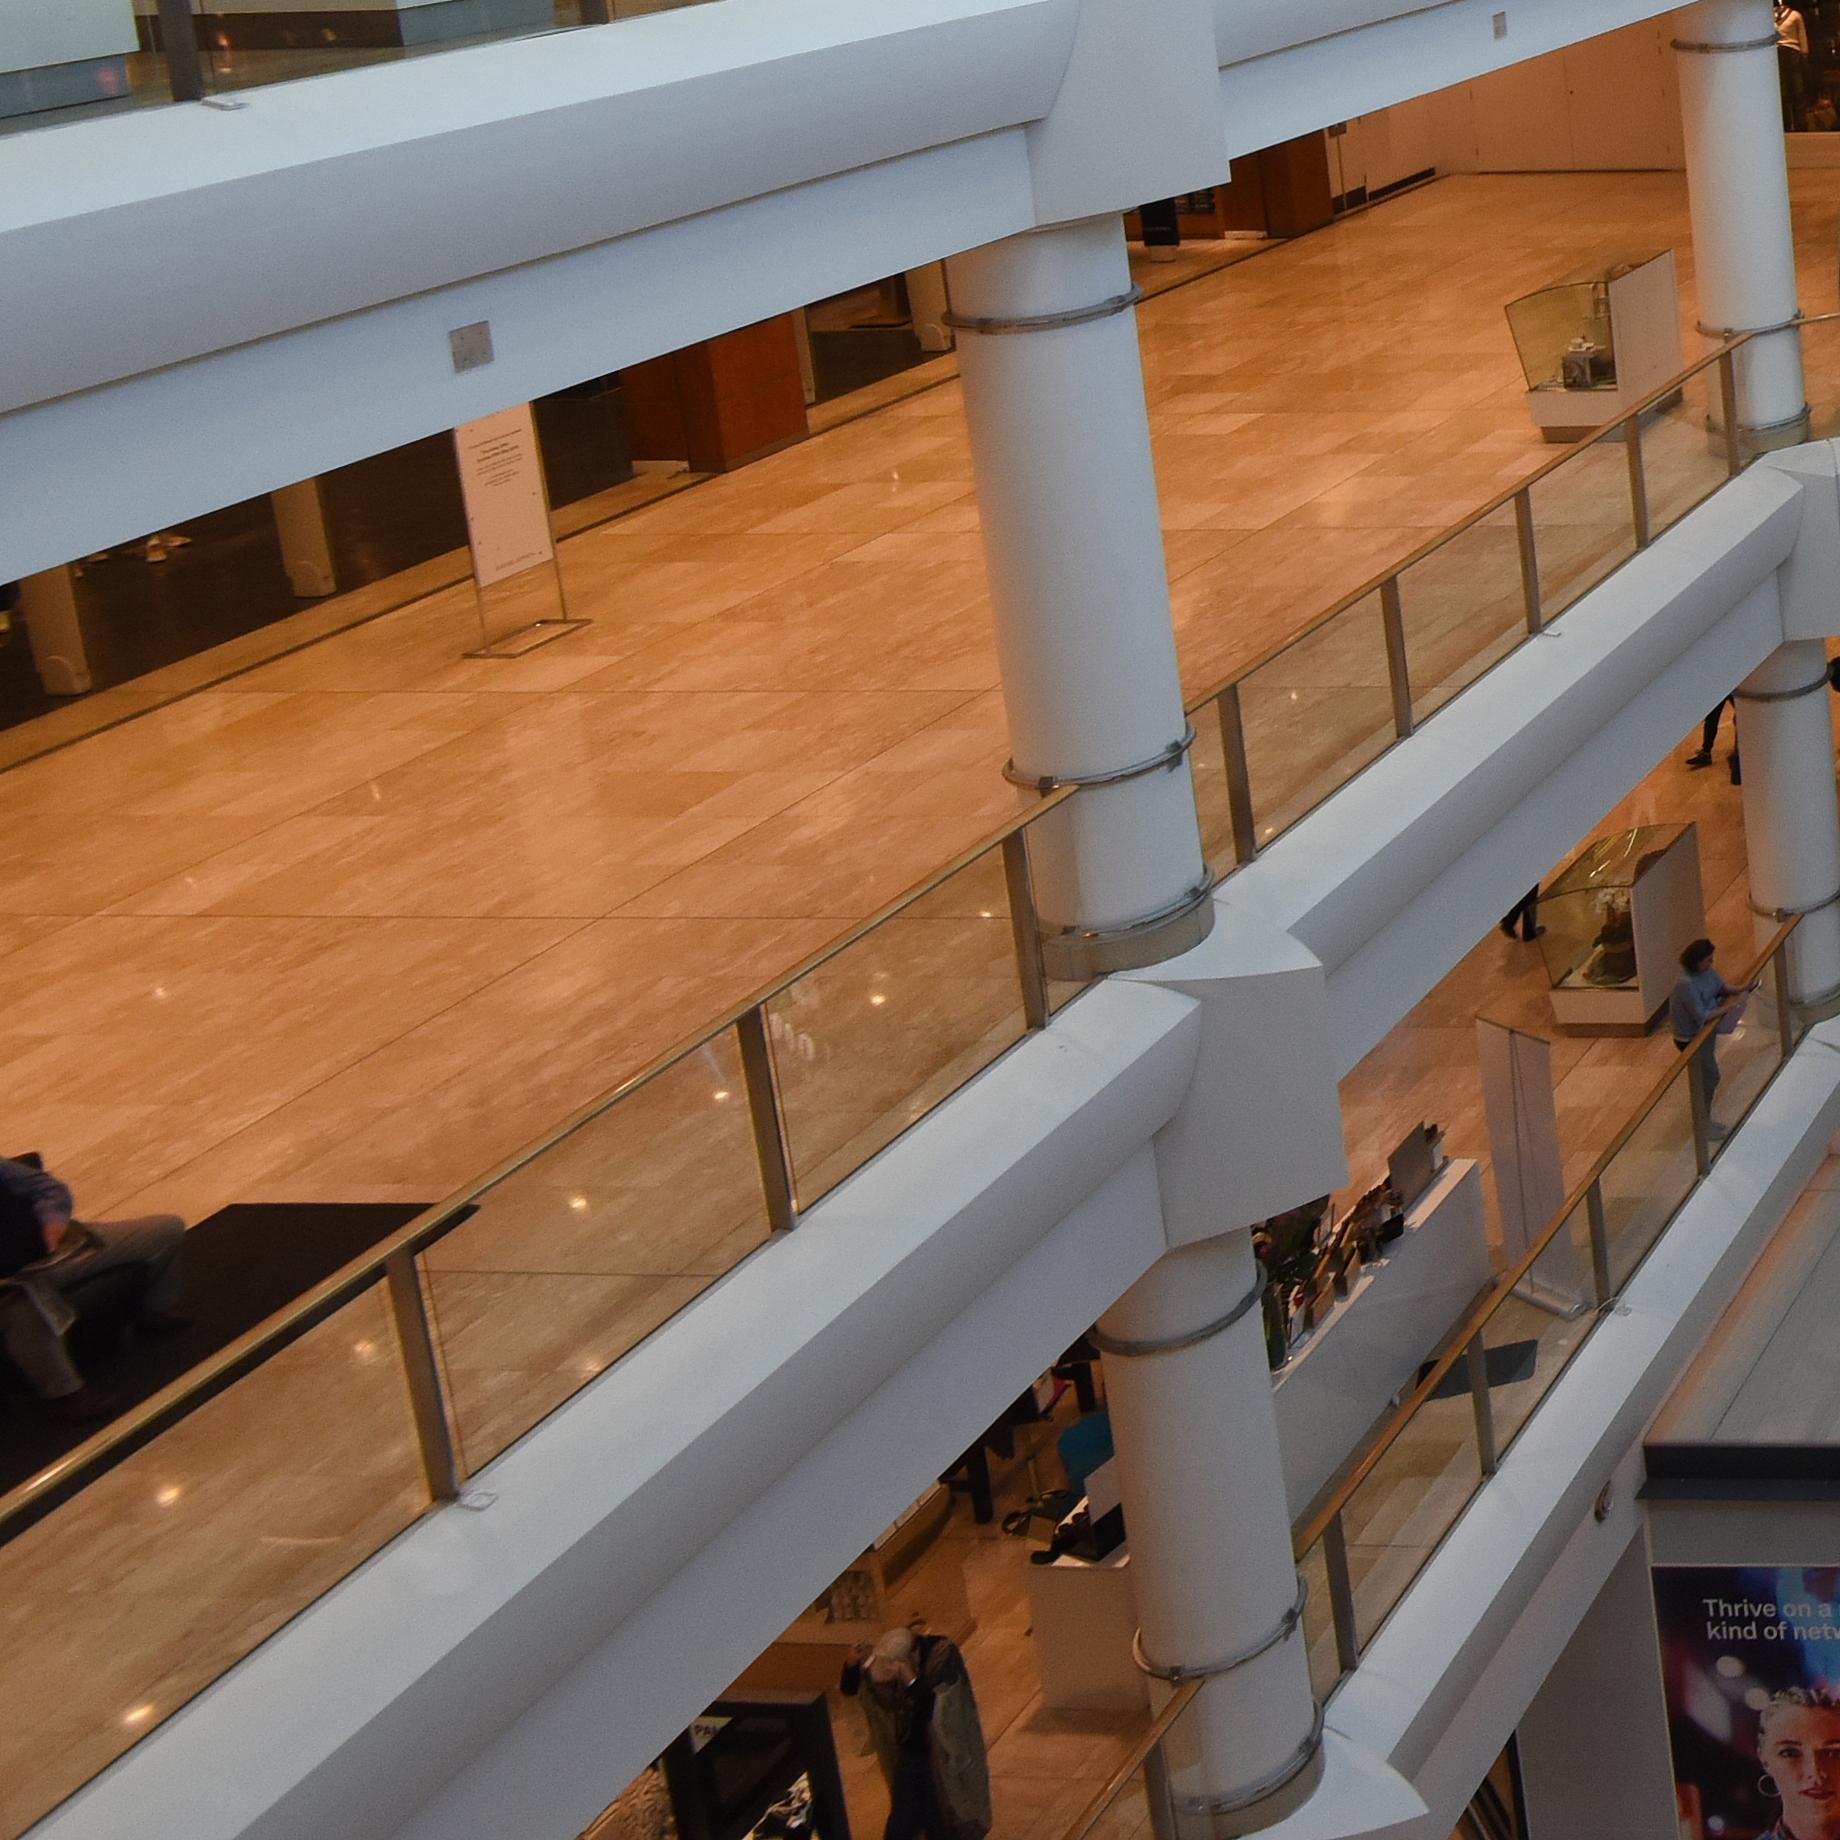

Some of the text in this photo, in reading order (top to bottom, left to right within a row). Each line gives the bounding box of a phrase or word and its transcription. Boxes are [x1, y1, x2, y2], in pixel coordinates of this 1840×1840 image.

[1702, 1598, 1776, 1617] Thrive
[1783, 1603, 1810, 1617] on
[1818, 1603, 1833, 1617] a
[1706, 1621, 1757, 1640] kind
[1763, 1621, 1788, 1640] of
